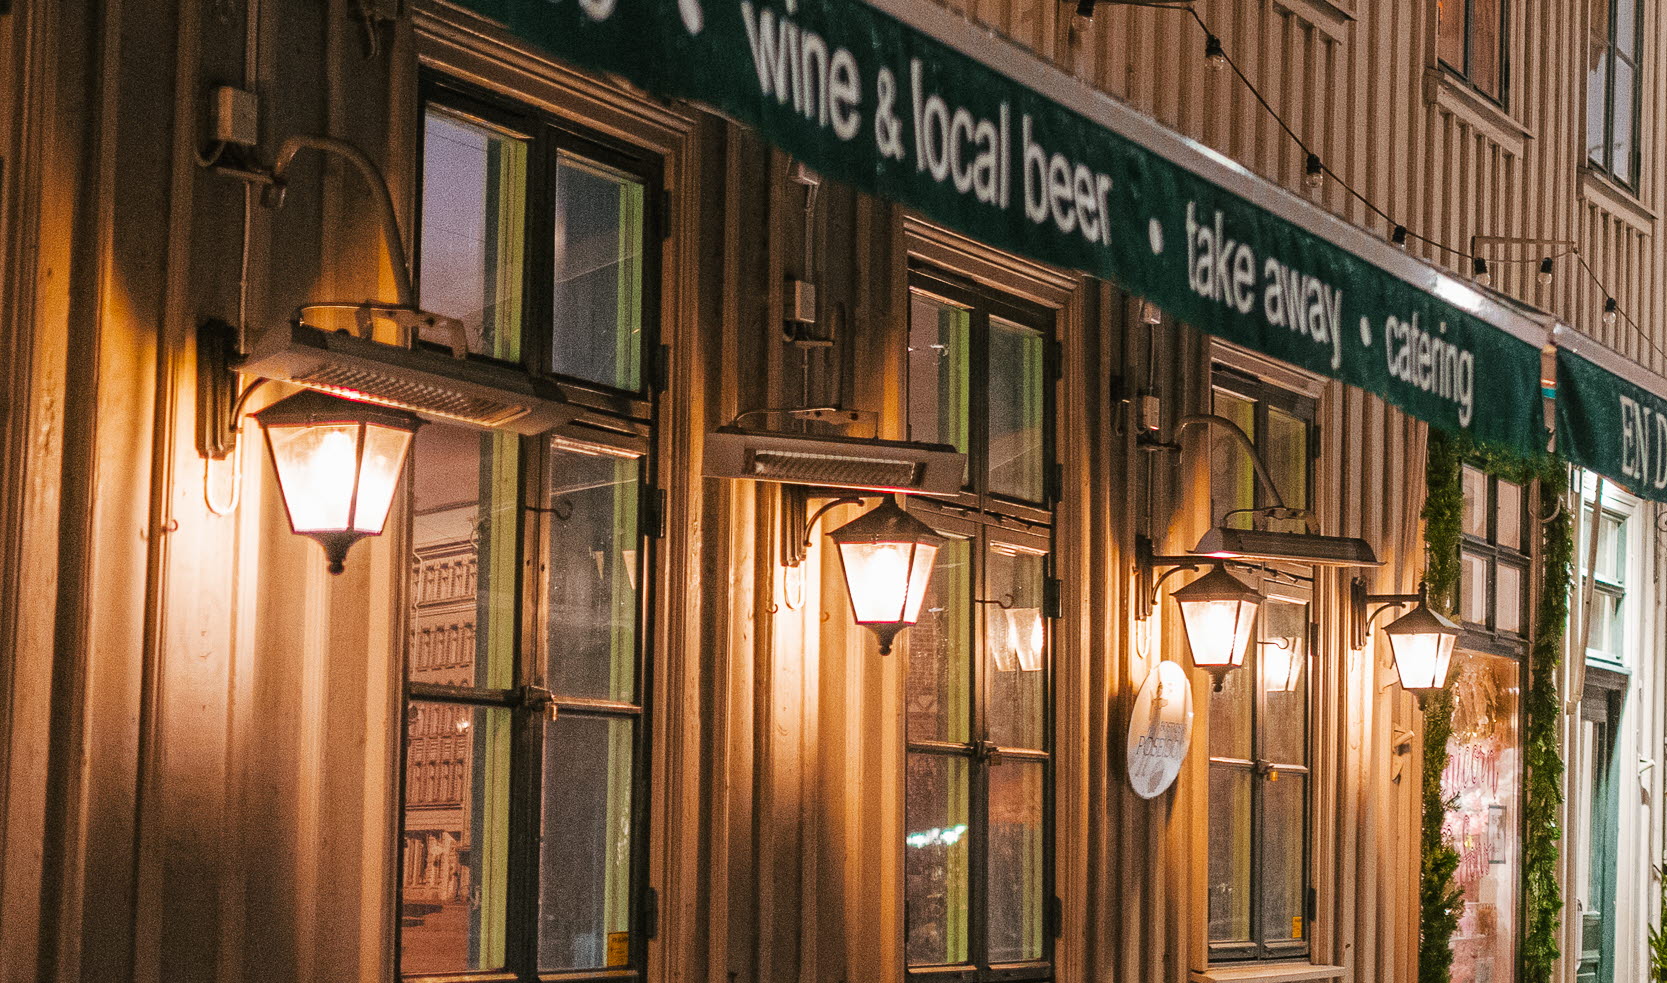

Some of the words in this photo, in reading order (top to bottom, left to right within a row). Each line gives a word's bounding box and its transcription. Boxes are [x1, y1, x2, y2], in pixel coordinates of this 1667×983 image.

[740, 0, 861, 141] wine
[874, 66, 906, 161] &
[911, 57, 1011, 209] local
[1022, 113, 1113, 247] beer
[1186, 200, 1256, 314] take
[1263, 257, 1342, 370] away
[1385, 311, 1475, 408] catering
[1619, 394, 1651, 487] EN
